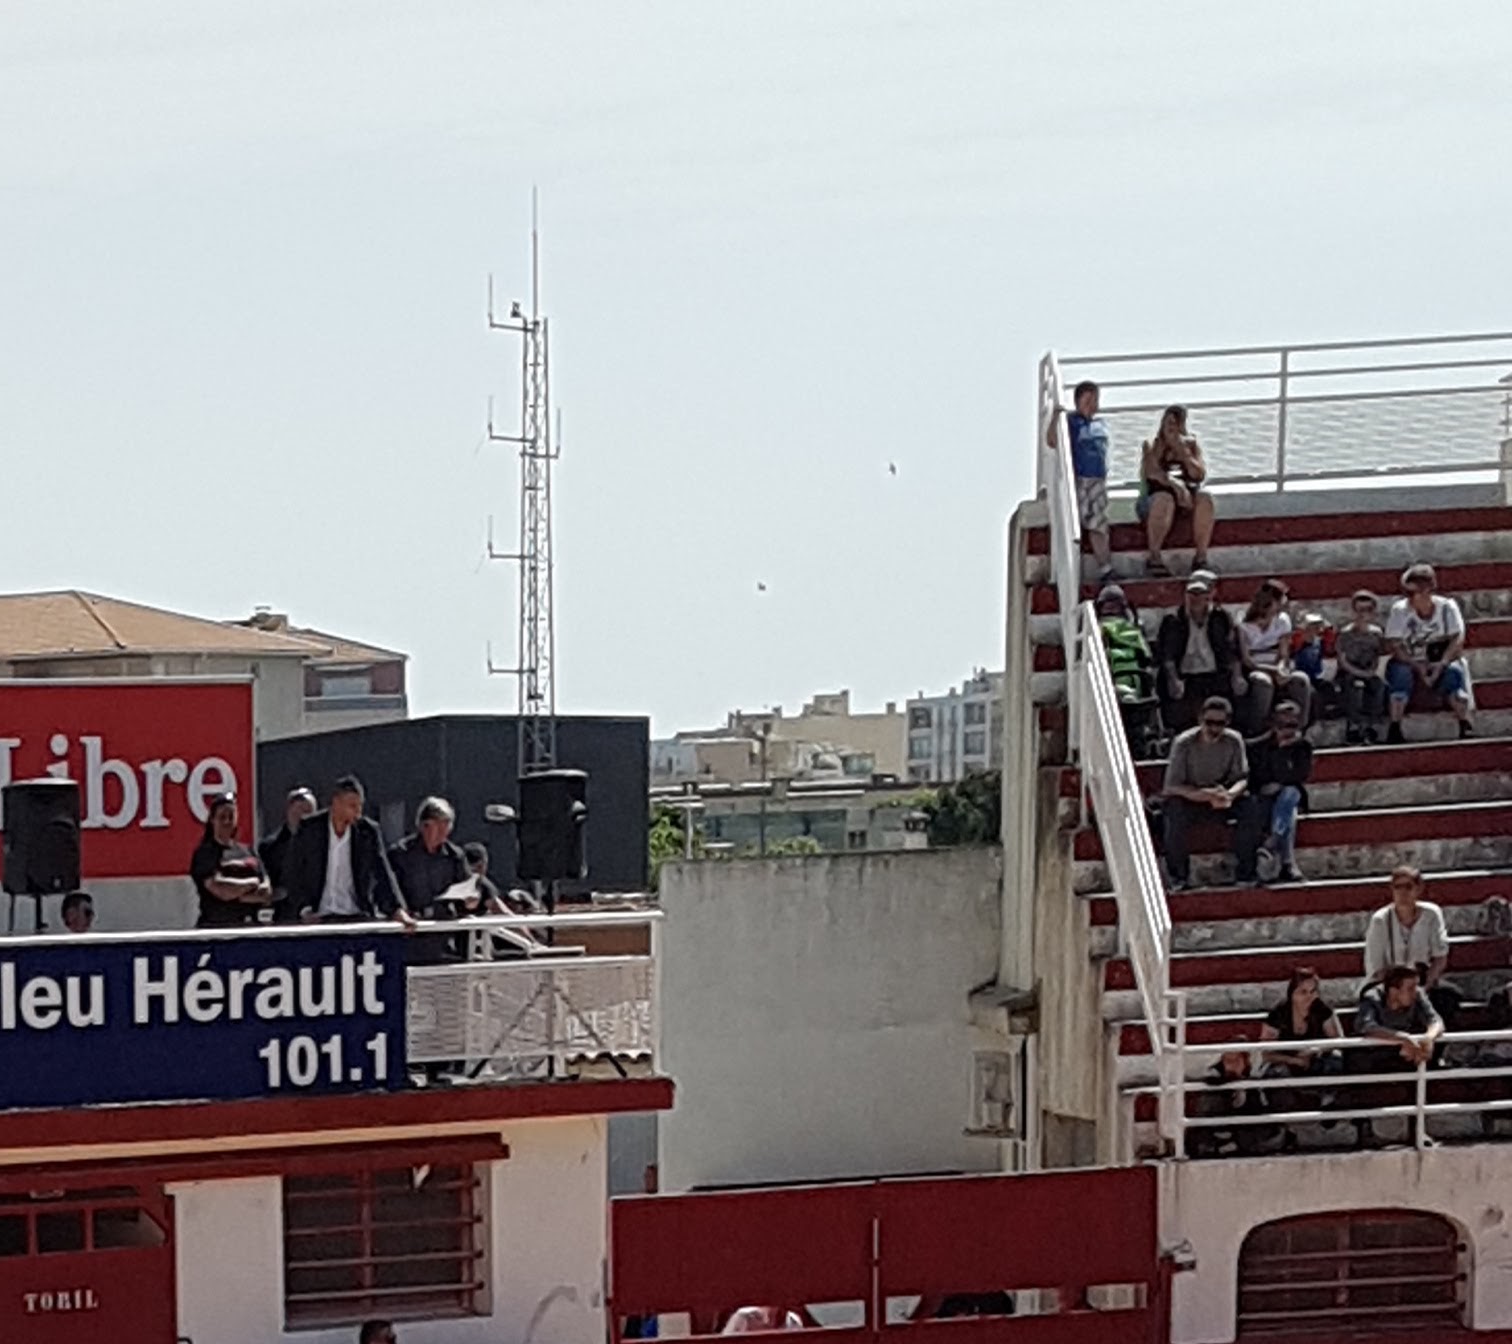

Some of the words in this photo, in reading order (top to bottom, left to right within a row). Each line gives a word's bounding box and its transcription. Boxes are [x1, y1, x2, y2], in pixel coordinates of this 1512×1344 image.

[133, 951, 385, 1024] Hérault
[259, 1032, 388, 1088] 101.1
[23, 1288, 99, 1313] TORIL
